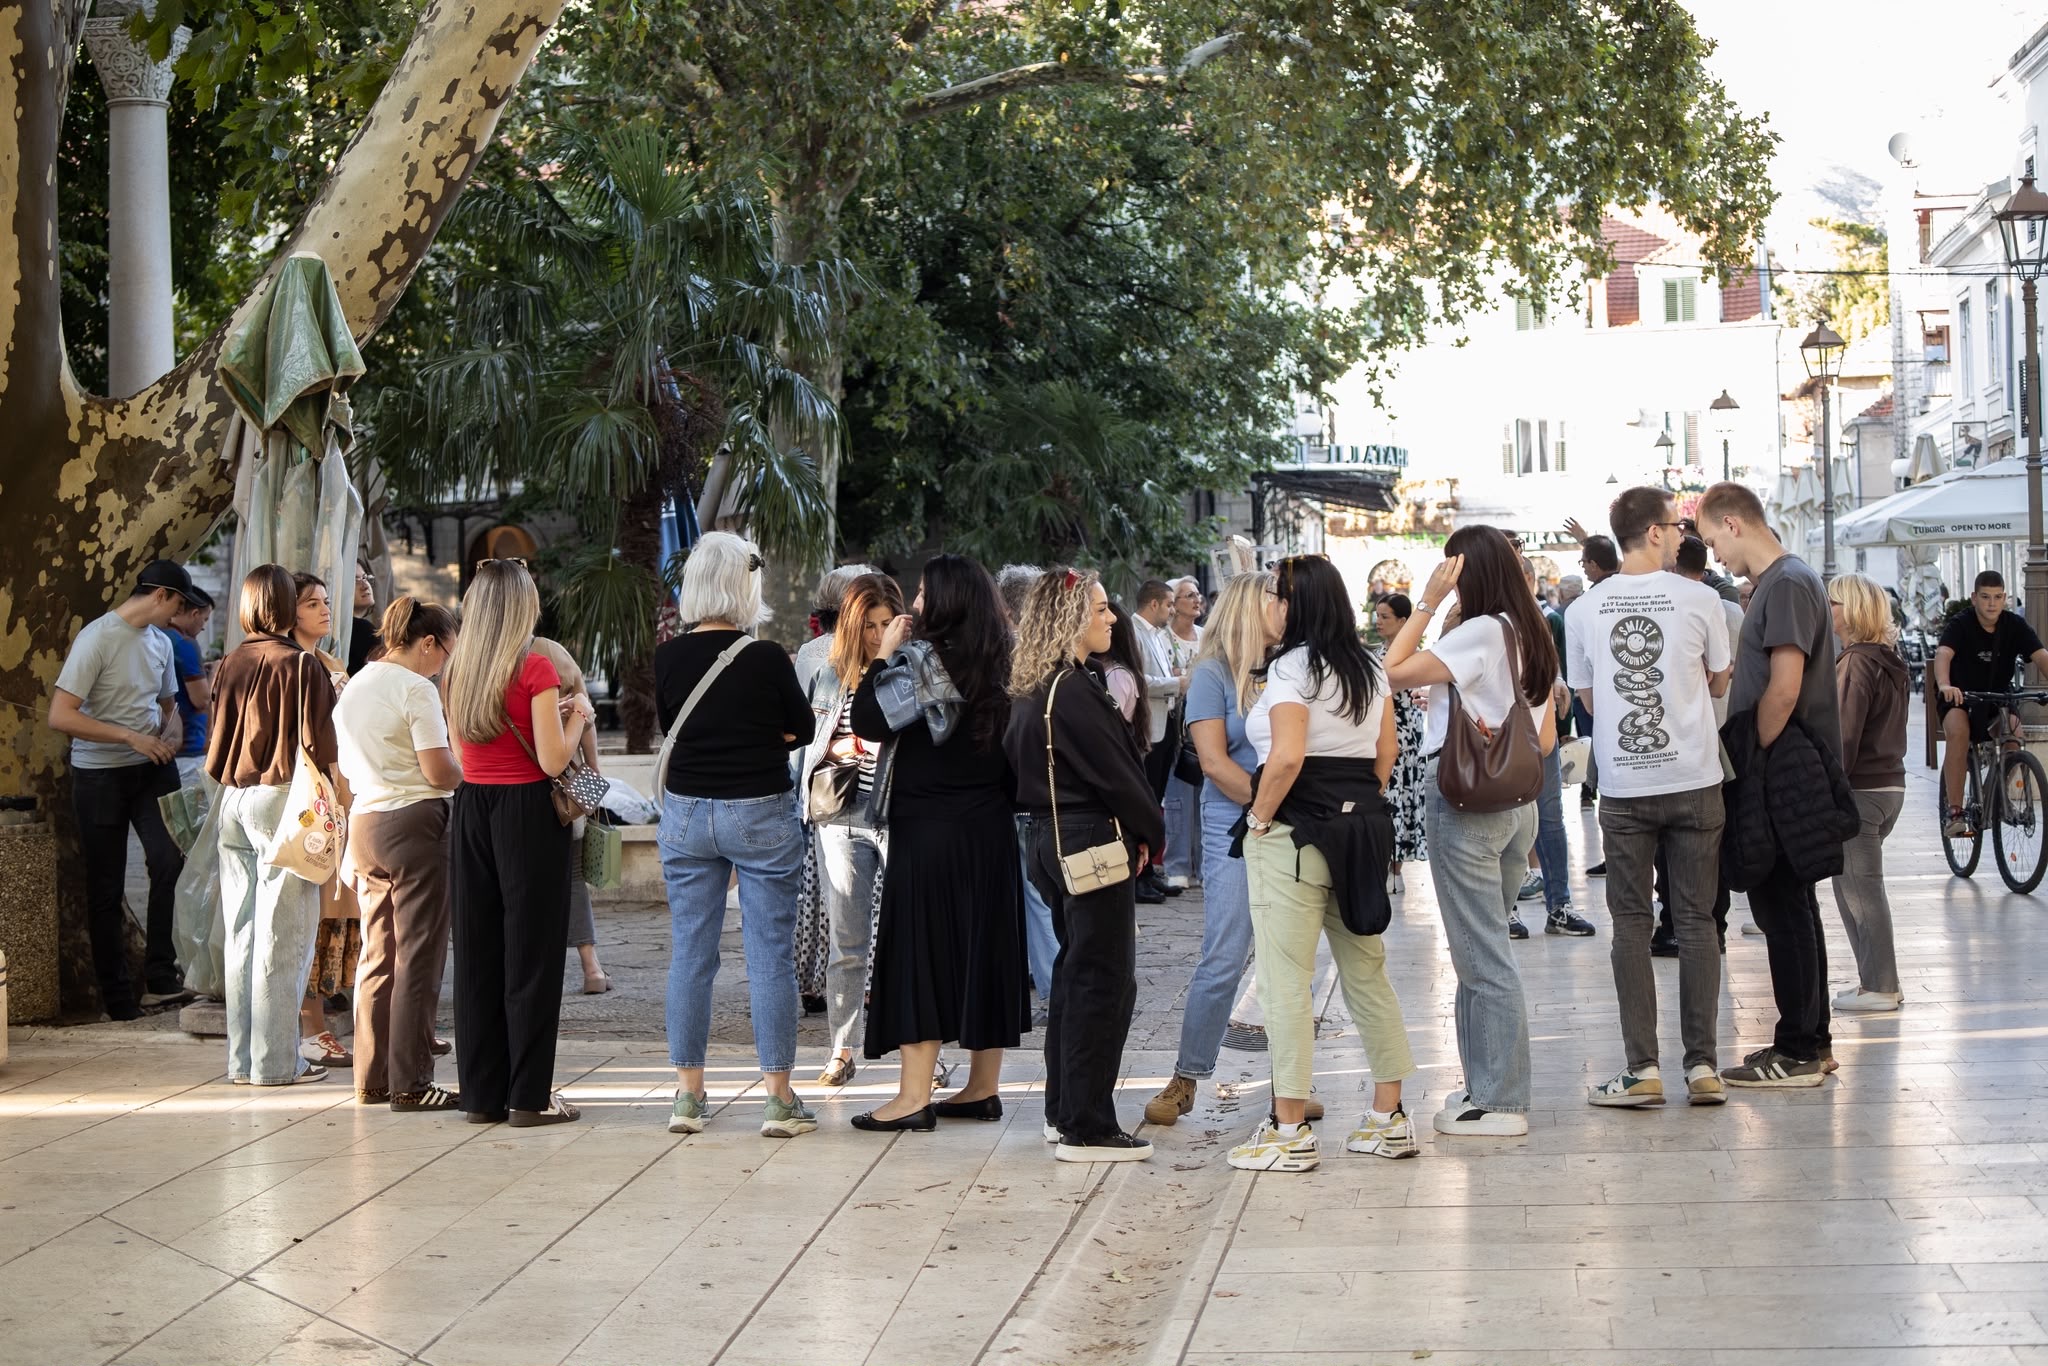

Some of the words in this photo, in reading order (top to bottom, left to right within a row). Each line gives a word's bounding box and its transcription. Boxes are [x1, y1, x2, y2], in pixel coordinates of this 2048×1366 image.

[1912, 525, 1946, 535] TUBORG
[1951, 524, 1973, 532] OPEN
[1975, 523, 1986, 531] TO
[1988, 522, 2012, 531] MORE
[1618, 619, 1658, 637] SMILEY
[1618, 650, 1653, 666] ORIGINALS
[1640, 750, 1679, 760] ORIGINALS
